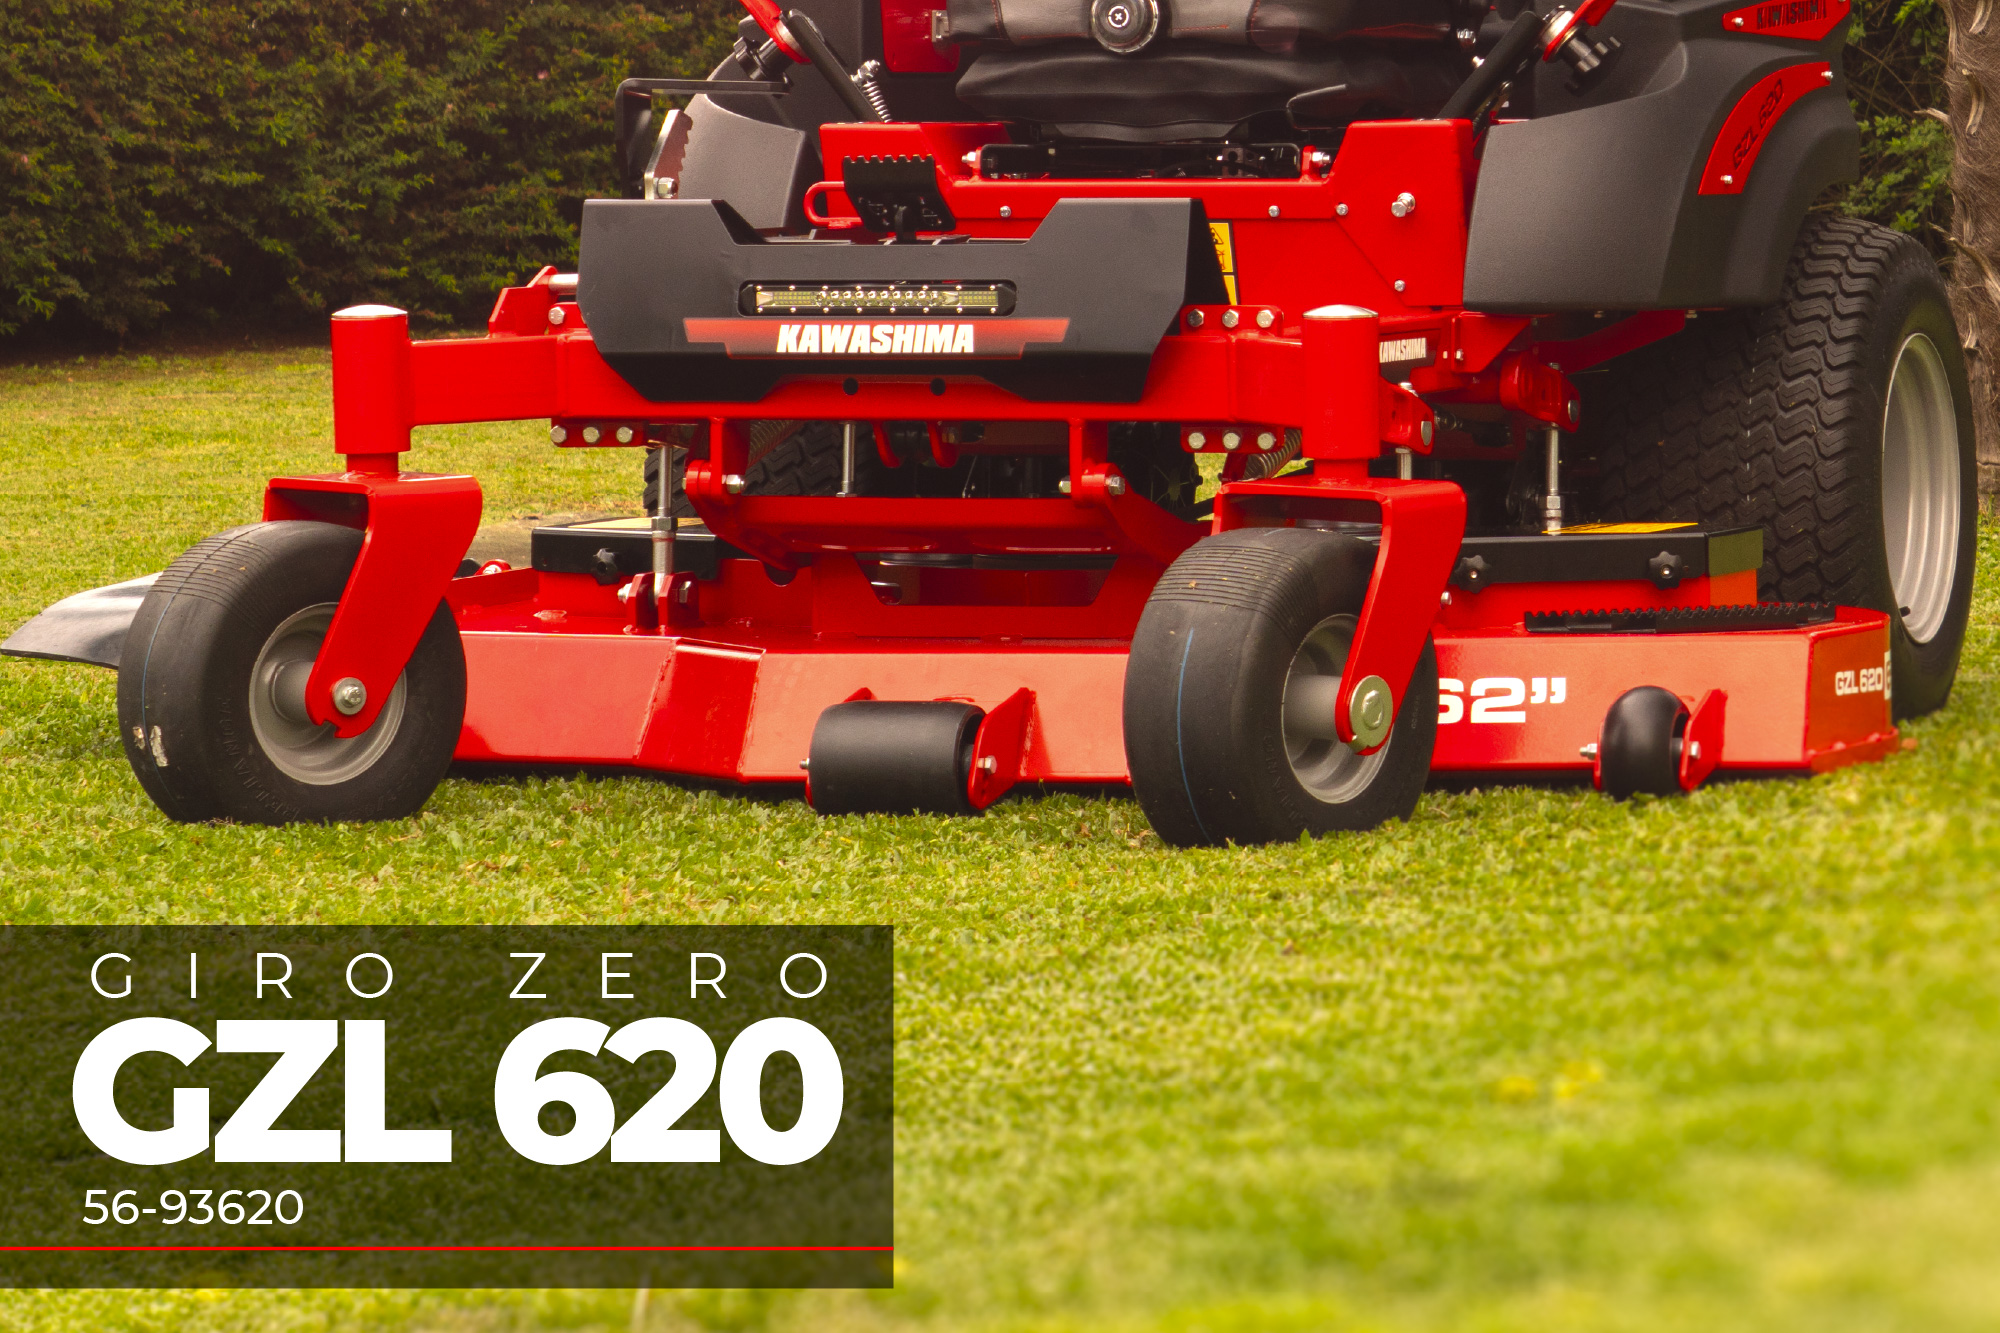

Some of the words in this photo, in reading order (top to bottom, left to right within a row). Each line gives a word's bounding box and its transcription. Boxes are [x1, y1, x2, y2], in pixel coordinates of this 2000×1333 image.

[1757, 0, 1827, 29] KAWASHIMA
[1733, 126, 1759, 170] GZL
[1759, 78, 1784, 130] 620
[777, 324, 974, 353] KAWASHIMA
[1835, 670, 1859, 696] GZL
[1860, 667, 1883, 693] 620
